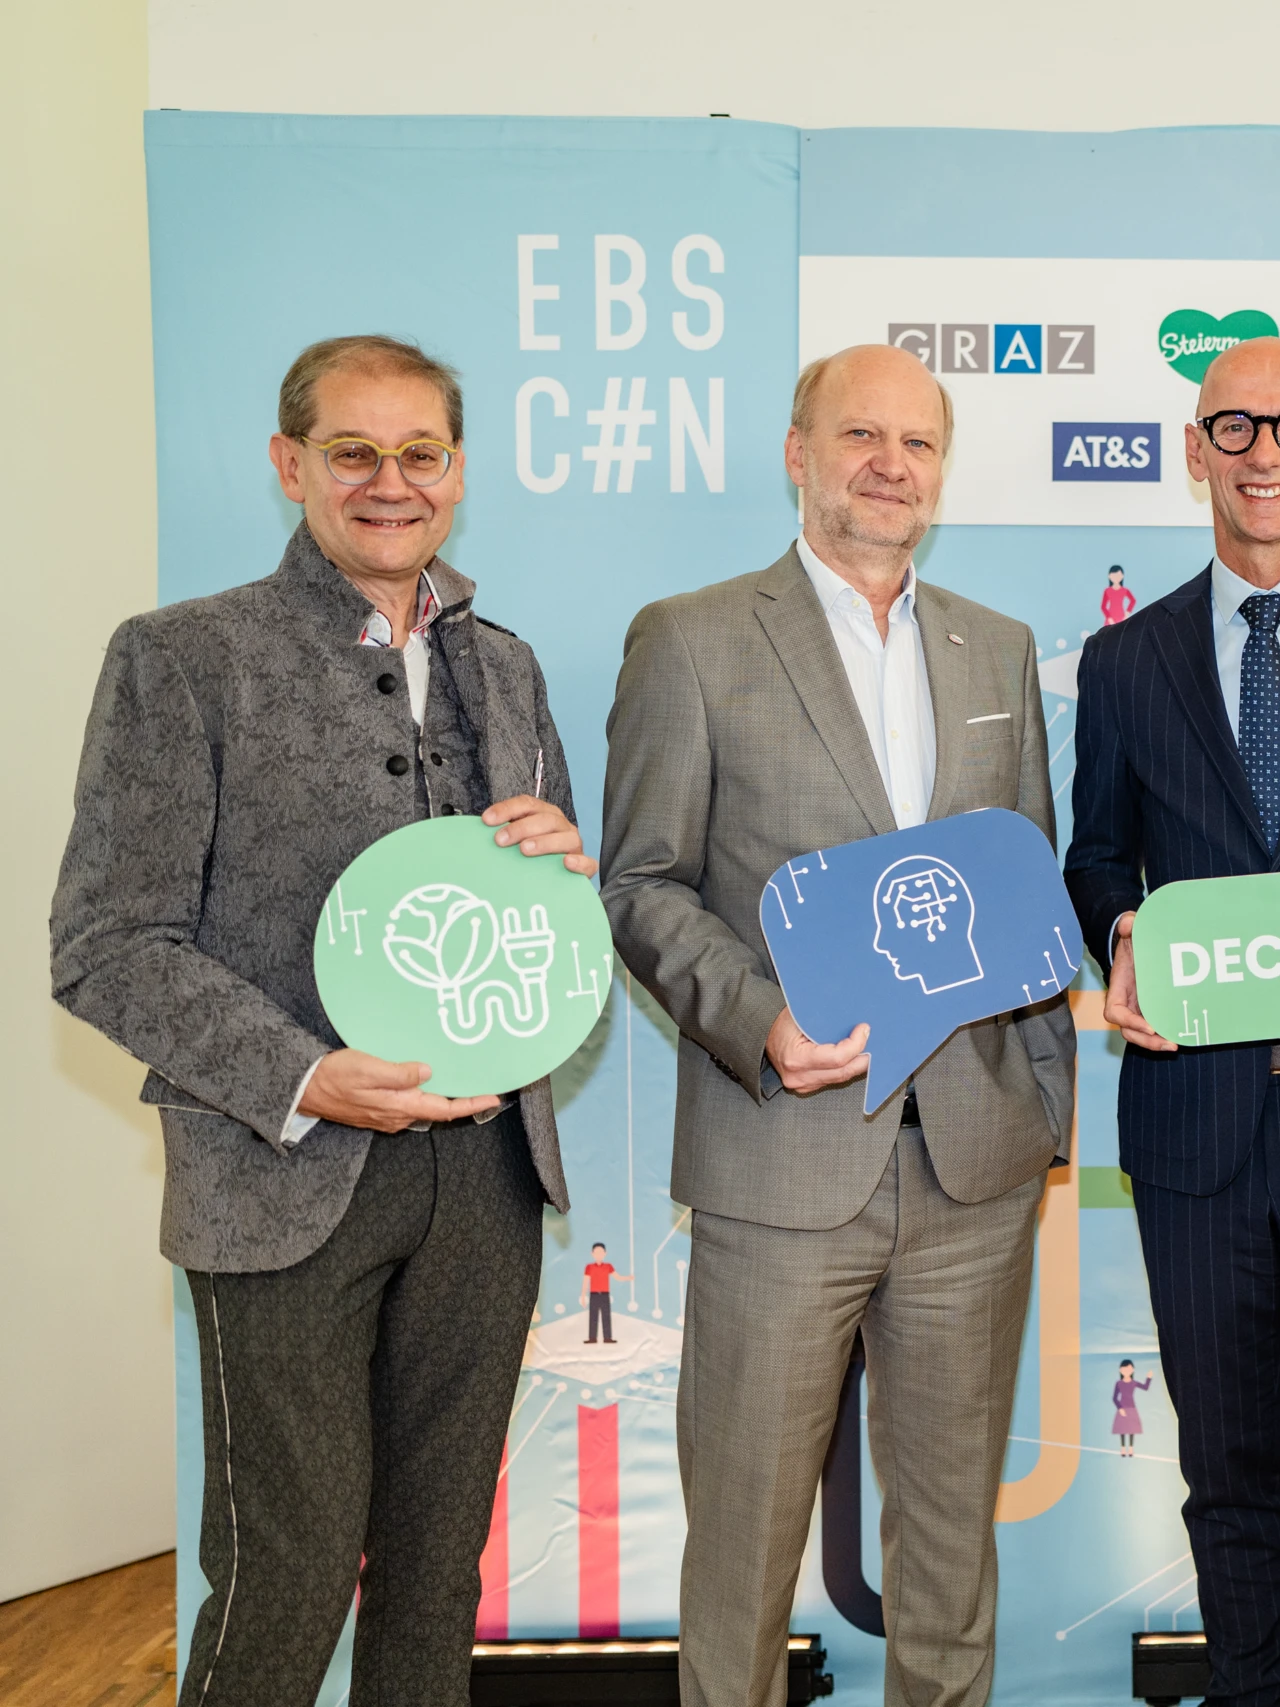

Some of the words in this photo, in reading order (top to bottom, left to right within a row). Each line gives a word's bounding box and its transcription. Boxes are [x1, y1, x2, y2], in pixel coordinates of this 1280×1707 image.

[517, 234, 725, 351] EBS
[894, 329, 1086, 370] GRAZ
[1161, 333, 1249, 362] Steierm
[1063, 436, 1150, 468] AT&S
